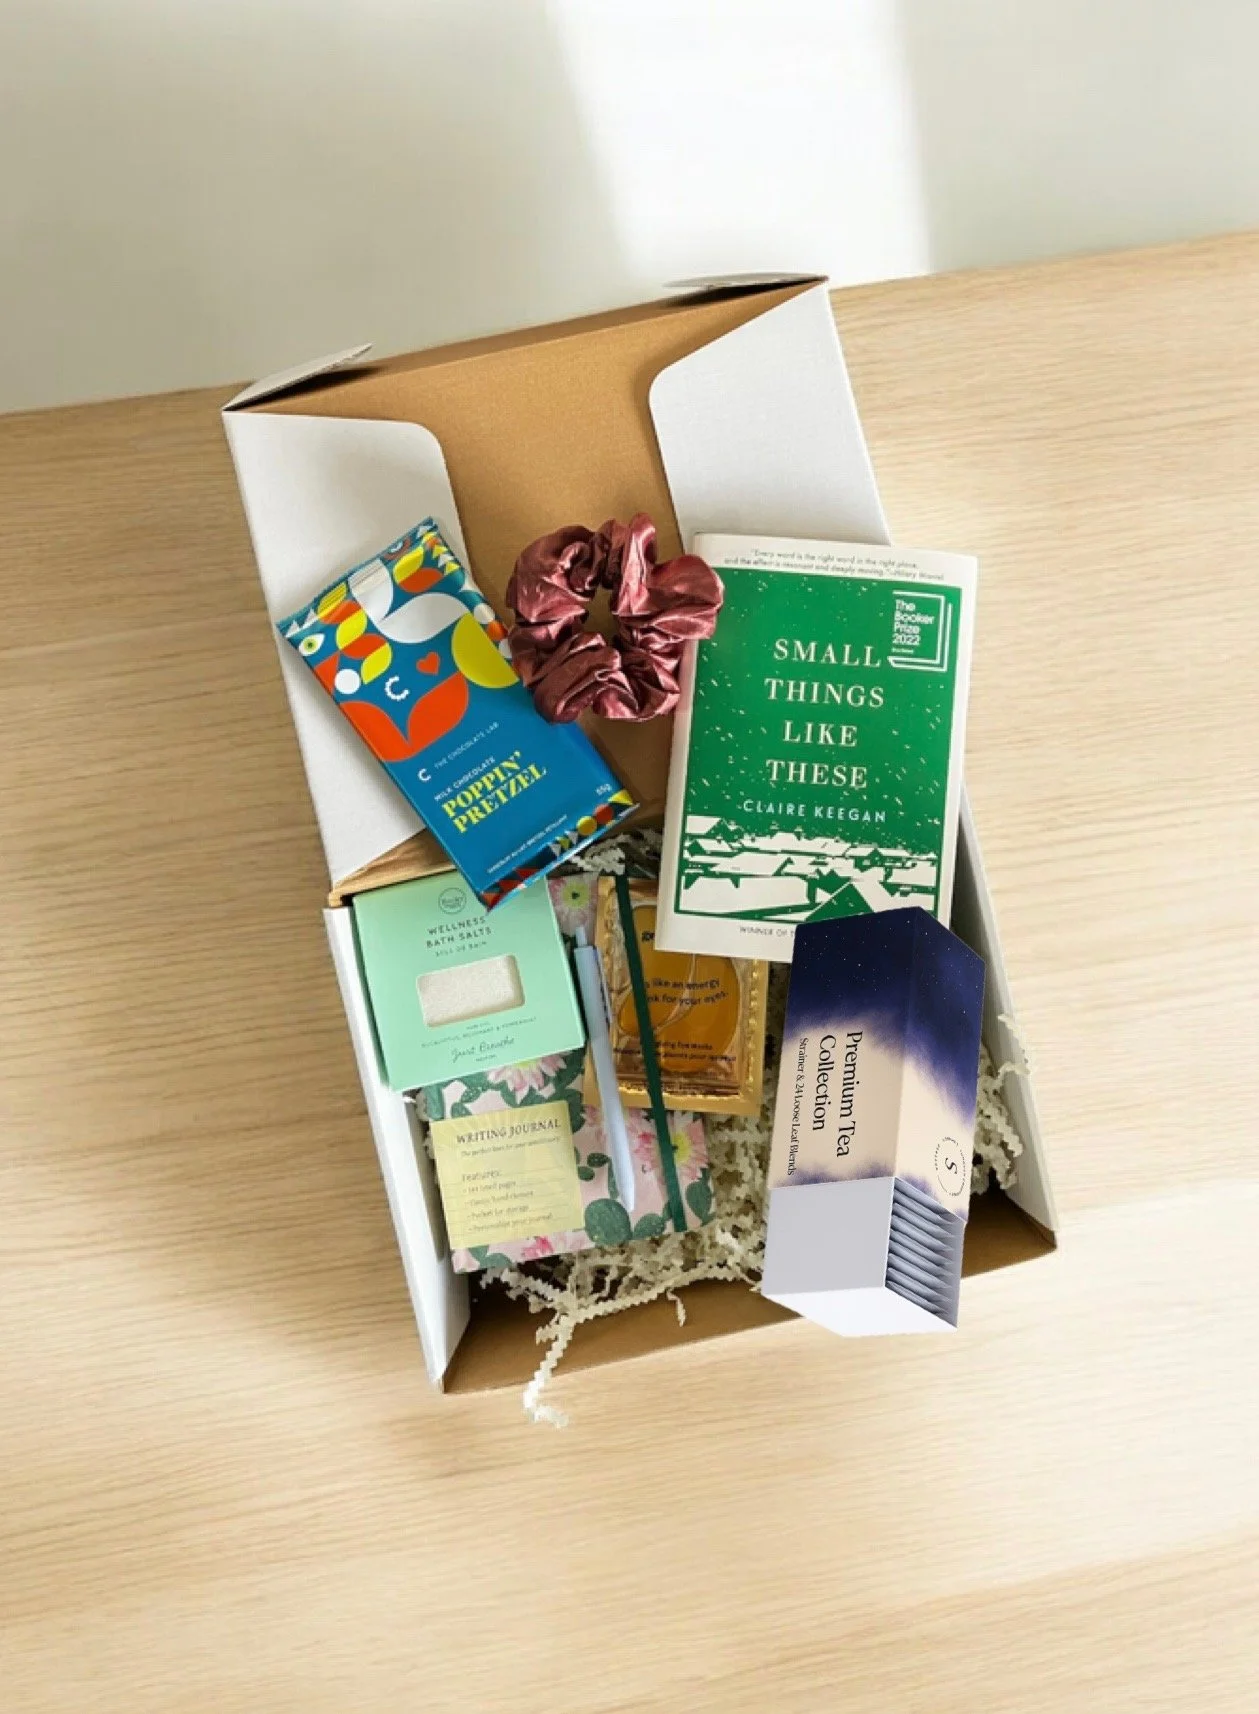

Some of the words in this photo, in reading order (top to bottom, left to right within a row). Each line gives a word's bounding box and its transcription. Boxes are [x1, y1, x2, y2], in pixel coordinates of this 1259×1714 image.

[895, 599, 916, 611] The
[894, 611, 935, 625] Booker
[894, 622, 921, 635] Prize
[892, 633, 921, 646] 2022
[773, 638, 881, 668] SMALL
[764, 678, 885, 708] THINGS
[447, 731, 486, 762] CHOCOLATE
[485, 721, 500, 734] LAB
[782, 719, 858, 748] LIKE
[434, 786, 454, 802] MILK
[452, 755, 497, 790] CHOCOLATE
[766, 759, 868, 789] THESE
[453, 762, 547, 834] PRETZEL
[743, 799, 807, 818] CLAIRE
[814, 806, 887, 824] KEEGAN
[426, 934, 455, 949] BATH
[458, 926, 492, 941] SALTS
[427, 915, 486, 936] WELLNESS
[739, 925, 773, 936] WINNER
[776, 928, 788, 938] OF
[652, 978, 671, 987] like
[671, 980, 684, 988] an
[685, 978, 720, 990] energy
[662, 993, 677, 1003] for
[679, 997, 701, 1005] your
[797, 1037, 809, 1072] Strainer
[795, 1074, 805, 1082] &
[812, 1034, 837, 1131] Collection
[839, 1031, 863, 1119] Premium
[795, 1083, 804, 1094] 24
[792, 1095, 803, 1122] Loose
[456, 1126, 507, 1144] WRITING
[508, 1118, 562, 1139] JOURNAL
[790, 1123, 801, 1143] Leaf
[836, 1120, 856, 1158] Tea
[787, 1144, 799, 1176] Blends
[944, 1157, 958, 1175] S
